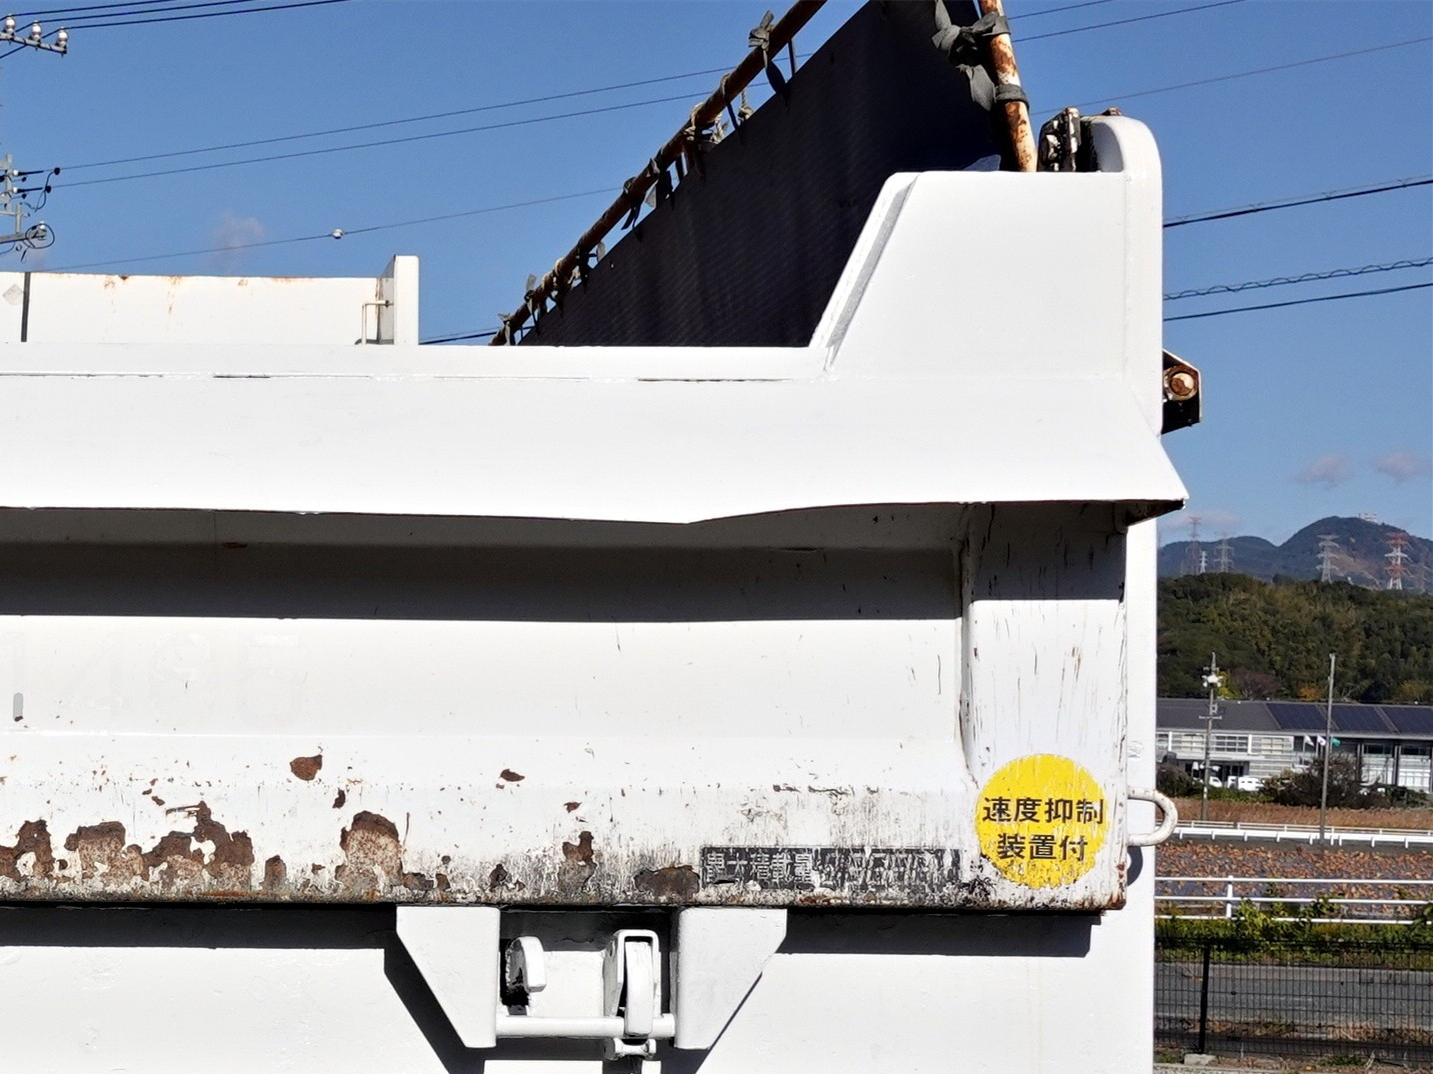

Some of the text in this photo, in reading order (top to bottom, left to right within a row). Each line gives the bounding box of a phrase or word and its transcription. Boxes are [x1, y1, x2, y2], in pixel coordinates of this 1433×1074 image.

[981, 796, 1105, 824] 速度抑制
[996, 832, 1089, 862] 装置付
